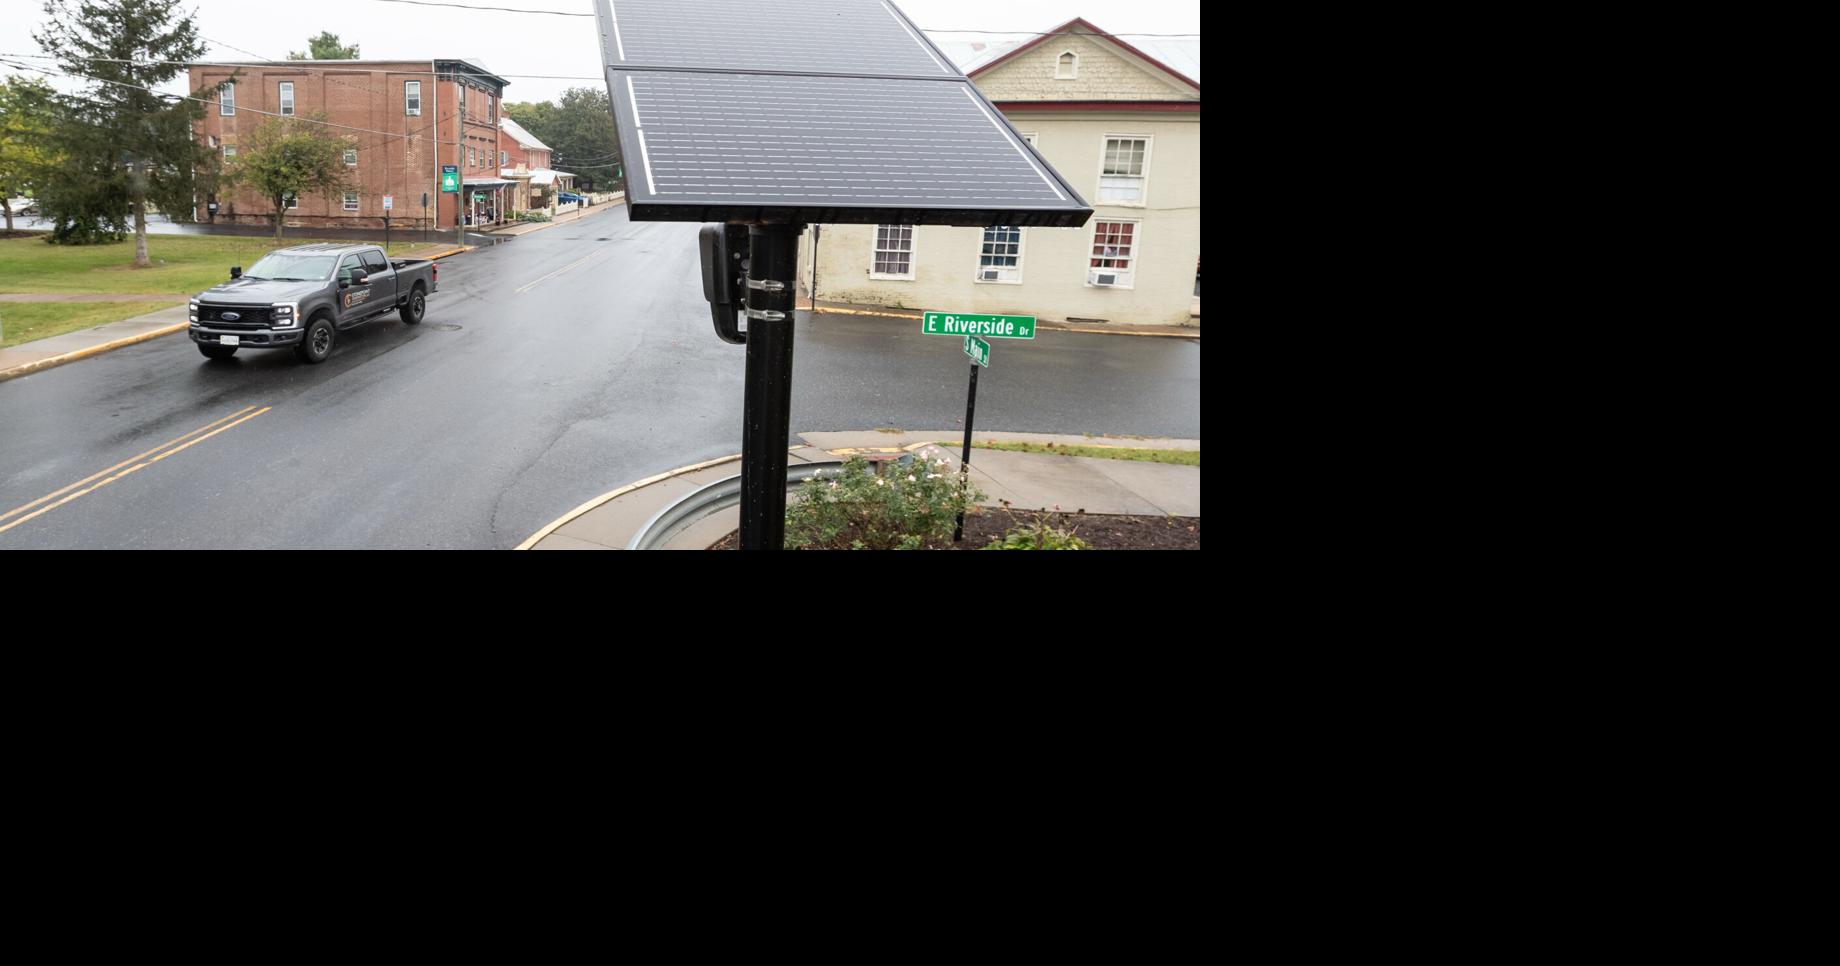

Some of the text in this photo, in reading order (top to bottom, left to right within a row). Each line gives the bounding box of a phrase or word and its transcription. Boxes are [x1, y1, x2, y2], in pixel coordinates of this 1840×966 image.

[928, 315, 1030, 336] E Riverside Dr
